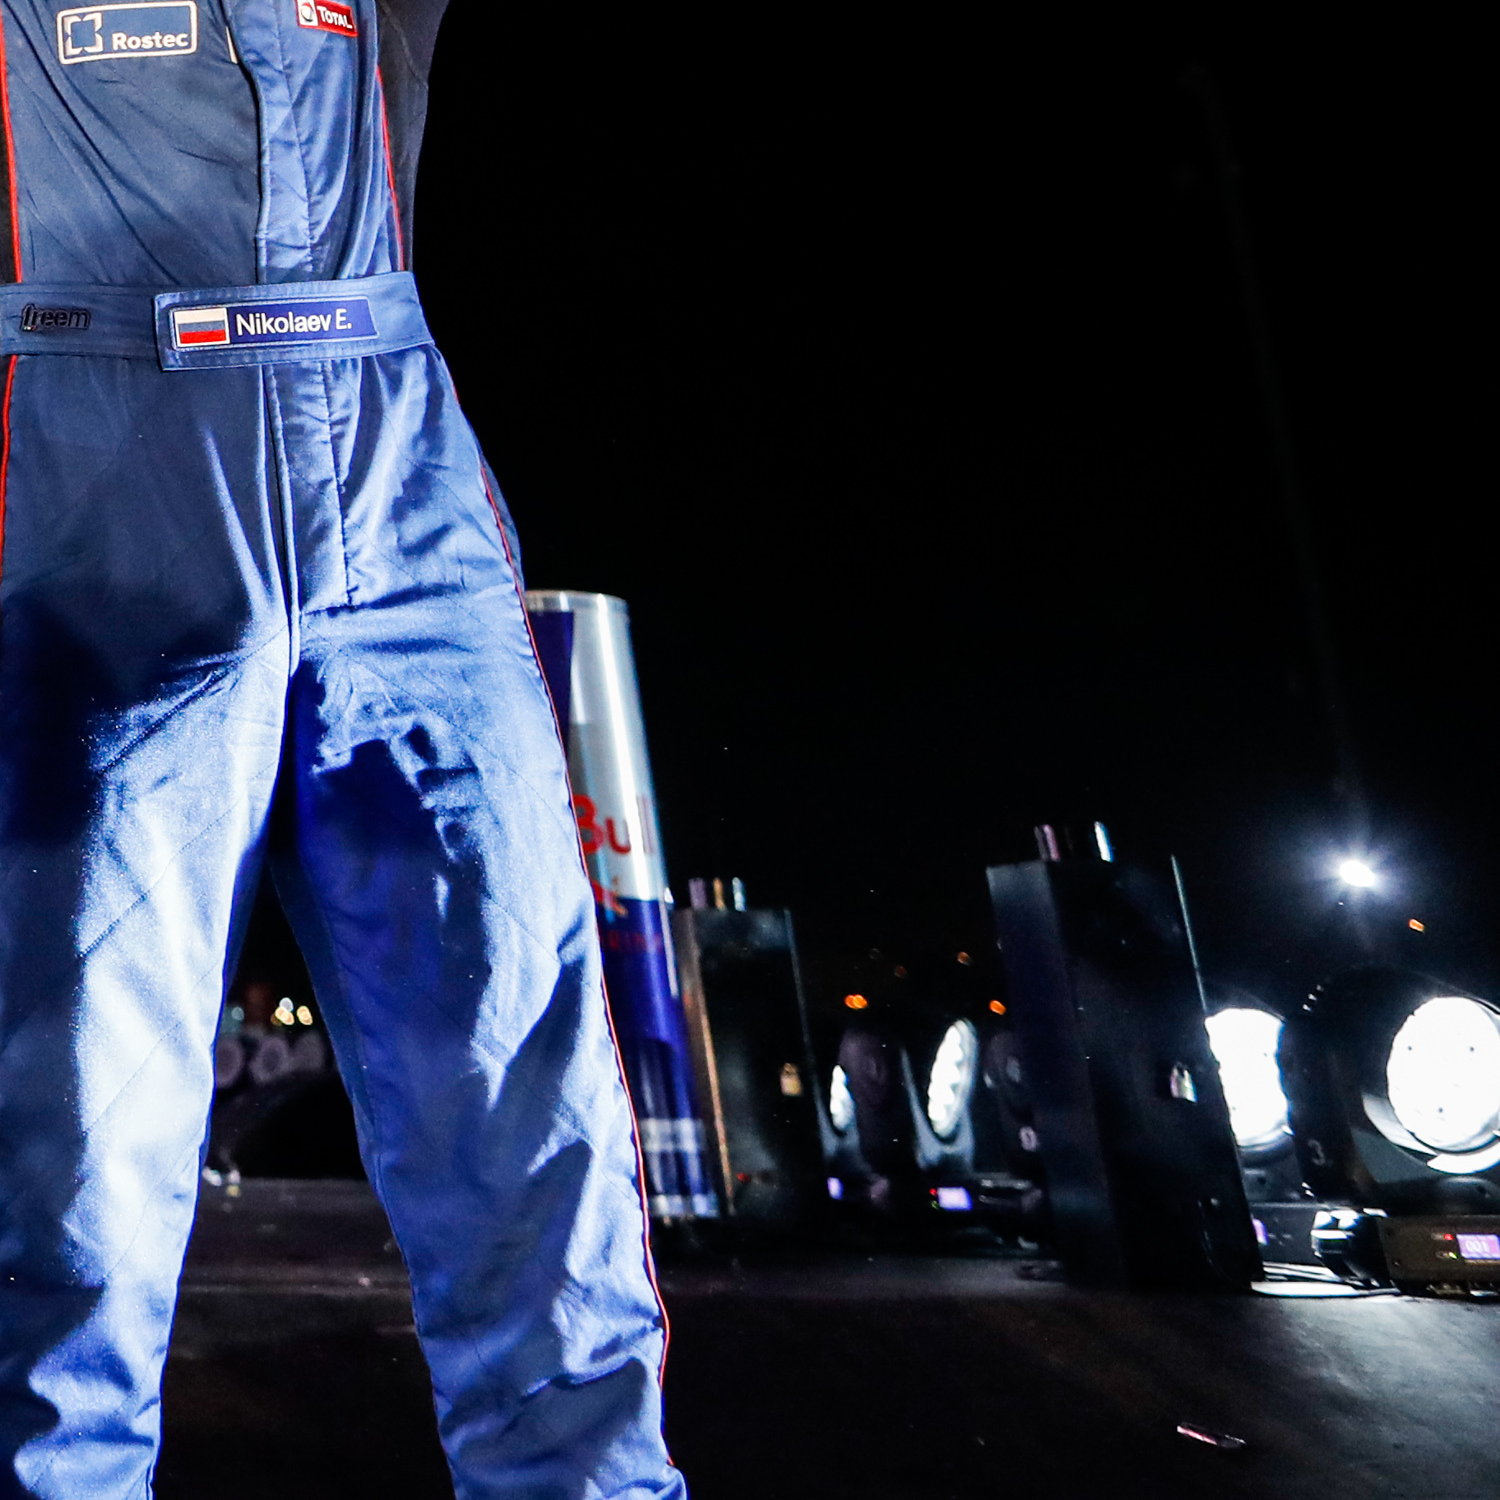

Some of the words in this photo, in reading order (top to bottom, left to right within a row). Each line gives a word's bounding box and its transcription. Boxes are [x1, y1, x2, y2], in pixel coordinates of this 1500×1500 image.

[112, 30, 189, 51] Rostec
[235, 309, 332, 336] Nikolaev
[334, 308, 353, 330] E.
